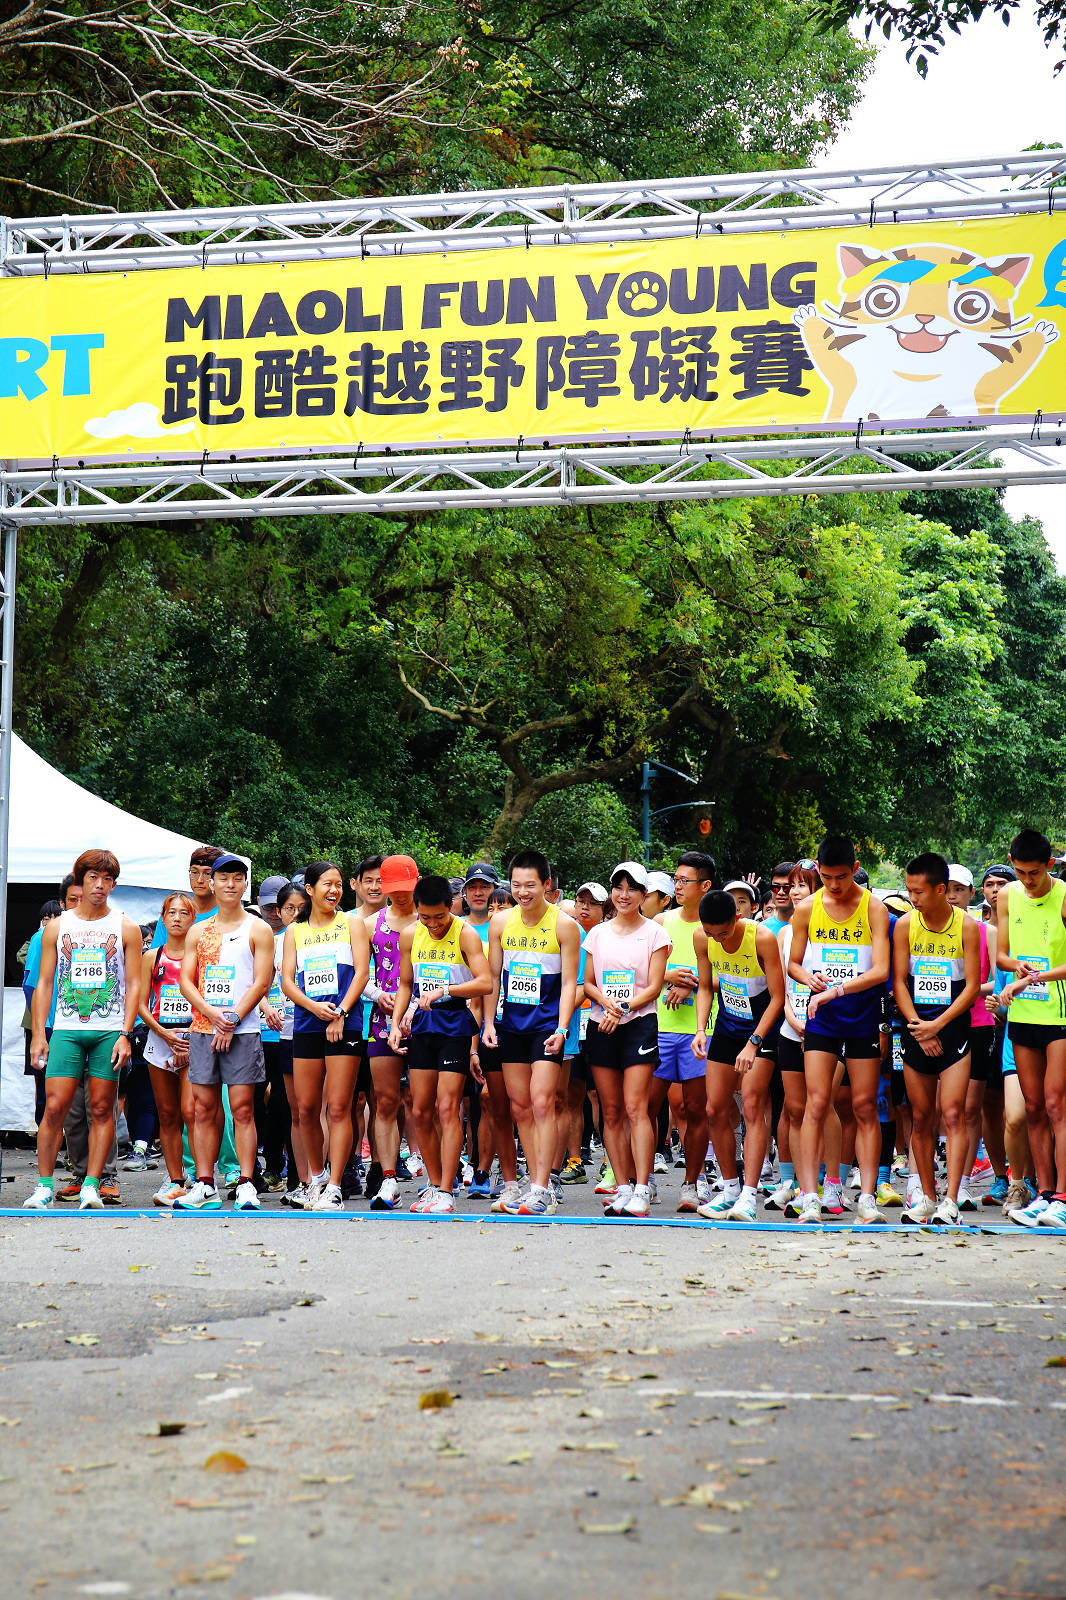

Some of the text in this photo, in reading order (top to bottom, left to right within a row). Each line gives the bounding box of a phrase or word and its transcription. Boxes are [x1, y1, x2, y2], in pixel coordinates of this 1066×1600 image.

[165, 261, 818, 343] MIAOLI FUN YOUNG
[162, 319, 815, 425] 跑酷越野障礙賽
[816, 927, 863, 942] 桃園高中
[75, 967, 103, 976] 2186
[825, 968, 854, 978] 2054
[308, 973, 334, 985] 2060
[206, 984, 231, 993] 2193
[422, 983, 443, 991] 205
[511, 980, 537, 992] 2056
[918, 981, 947, 991] 2059
[163, 1002, 189, 1012] 2185
[724, 996, 747, 1008] 2058
